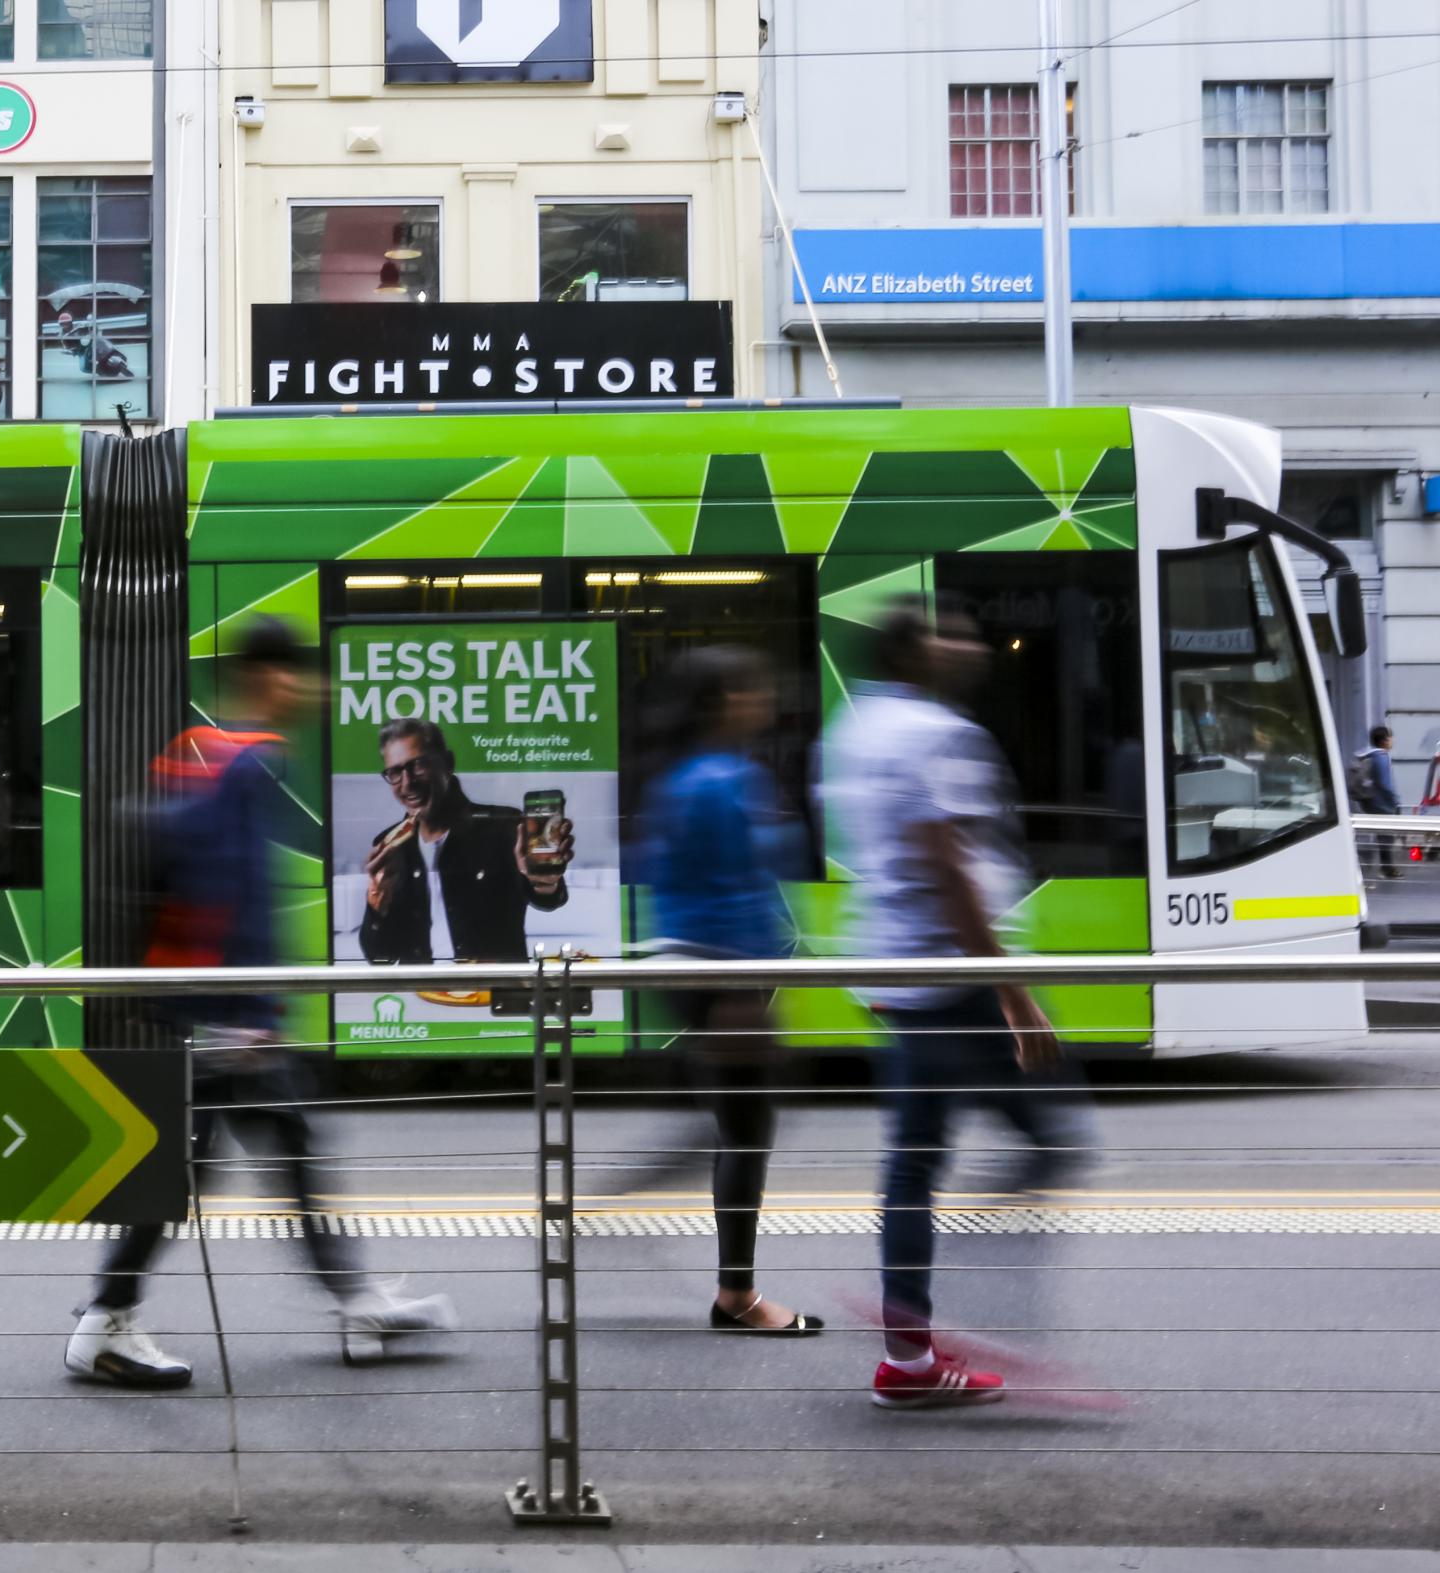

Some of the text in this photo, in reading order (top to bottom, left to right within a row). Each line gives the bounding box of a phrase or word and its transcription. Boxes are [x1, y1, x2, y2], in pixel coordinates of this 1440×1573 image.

[821, 272, 1033, 294] ANZ Elizabeth Street
[432, 333, 531, 352] MMA
[268, 358, 717, 401] FIGHT STORE
[339, 639, 594, 682] LESS TALK
[339, 683, 599, 726] MORE EAT.
[472, 733, 570, 748] Your favourite
[525, 749, 594, 762] delivered.
[1167, 892, 1229, 926] 5015
[349, 1025, 429, 1039] MENULOG
